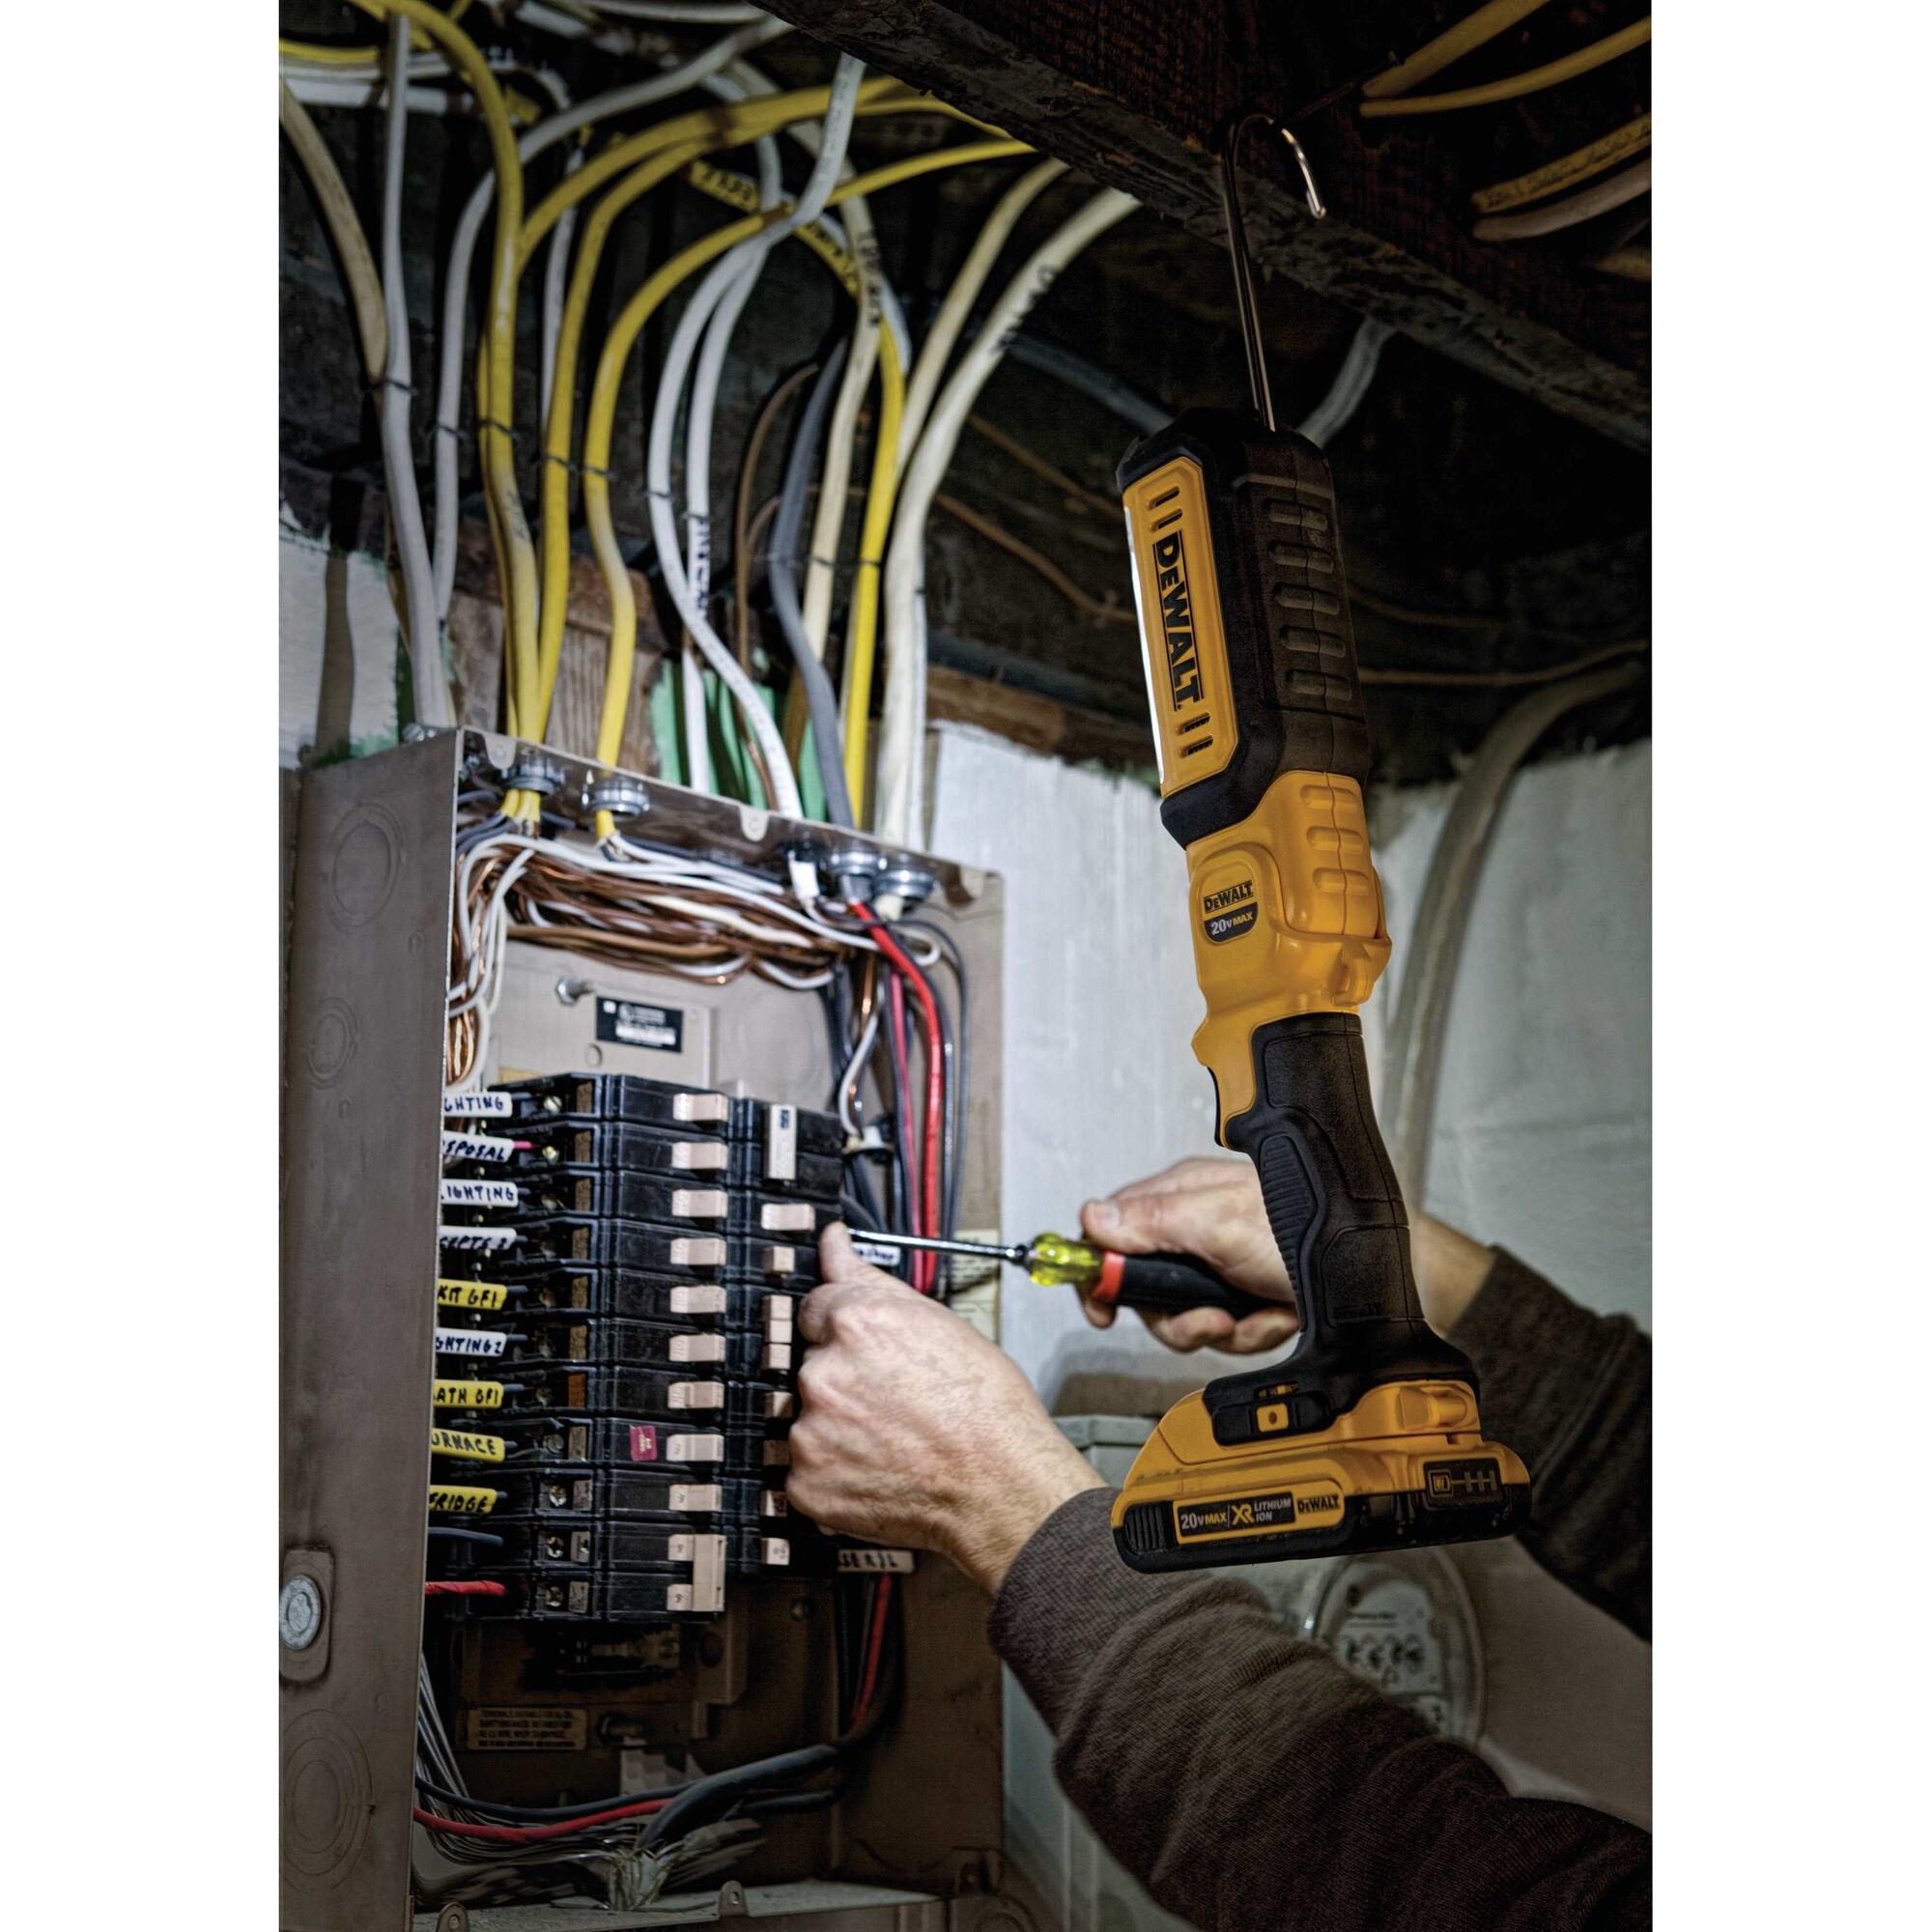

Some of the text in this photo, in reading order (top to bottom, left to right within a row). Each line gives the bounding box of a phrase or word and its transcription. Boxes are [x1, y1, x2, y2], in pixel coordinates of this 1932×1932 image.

[1157, 534, 1202, 711] DEWALT
[1206, 882, 1254, 912] DEWALT
[442, 1140, 505, 1160] SPOSAL
[440, 1185, 515, 1202] IGHTING
[433, 1387, 468, 1405] ATH
[1254, 1498, 1292, 1513] LITHIUM
[1256, 1512, 1273, 1522] ION
